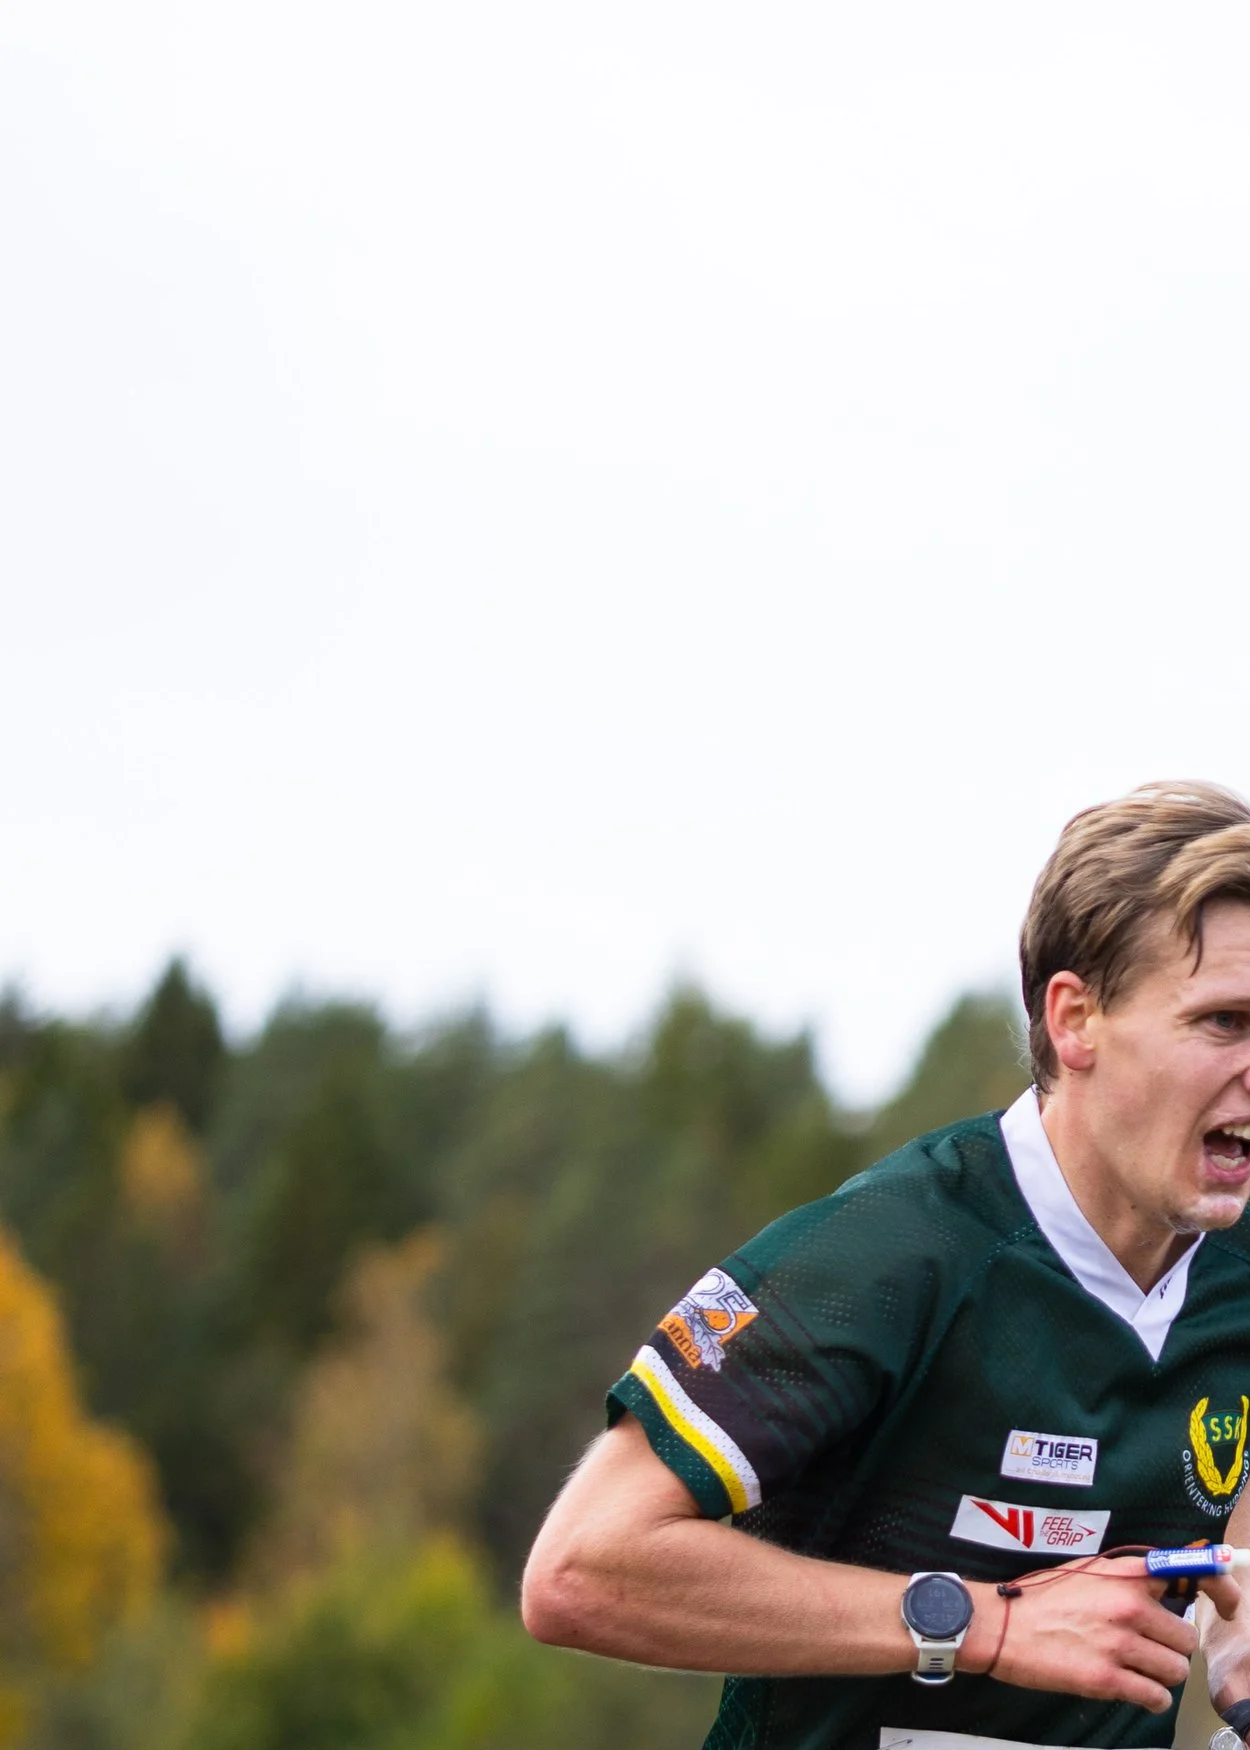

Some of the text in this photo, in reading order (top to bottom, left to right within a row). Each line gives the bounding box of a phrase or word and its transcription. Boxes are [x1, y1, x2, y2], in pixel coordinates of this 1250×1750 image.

[662, 1319, 702, 1363] anna
[1031, 1456, 1079, 1471] SPORTS
[1041, 1516, 1073, 1531] FEEL
[1046, 1531, 1084, 1546] GRIP
